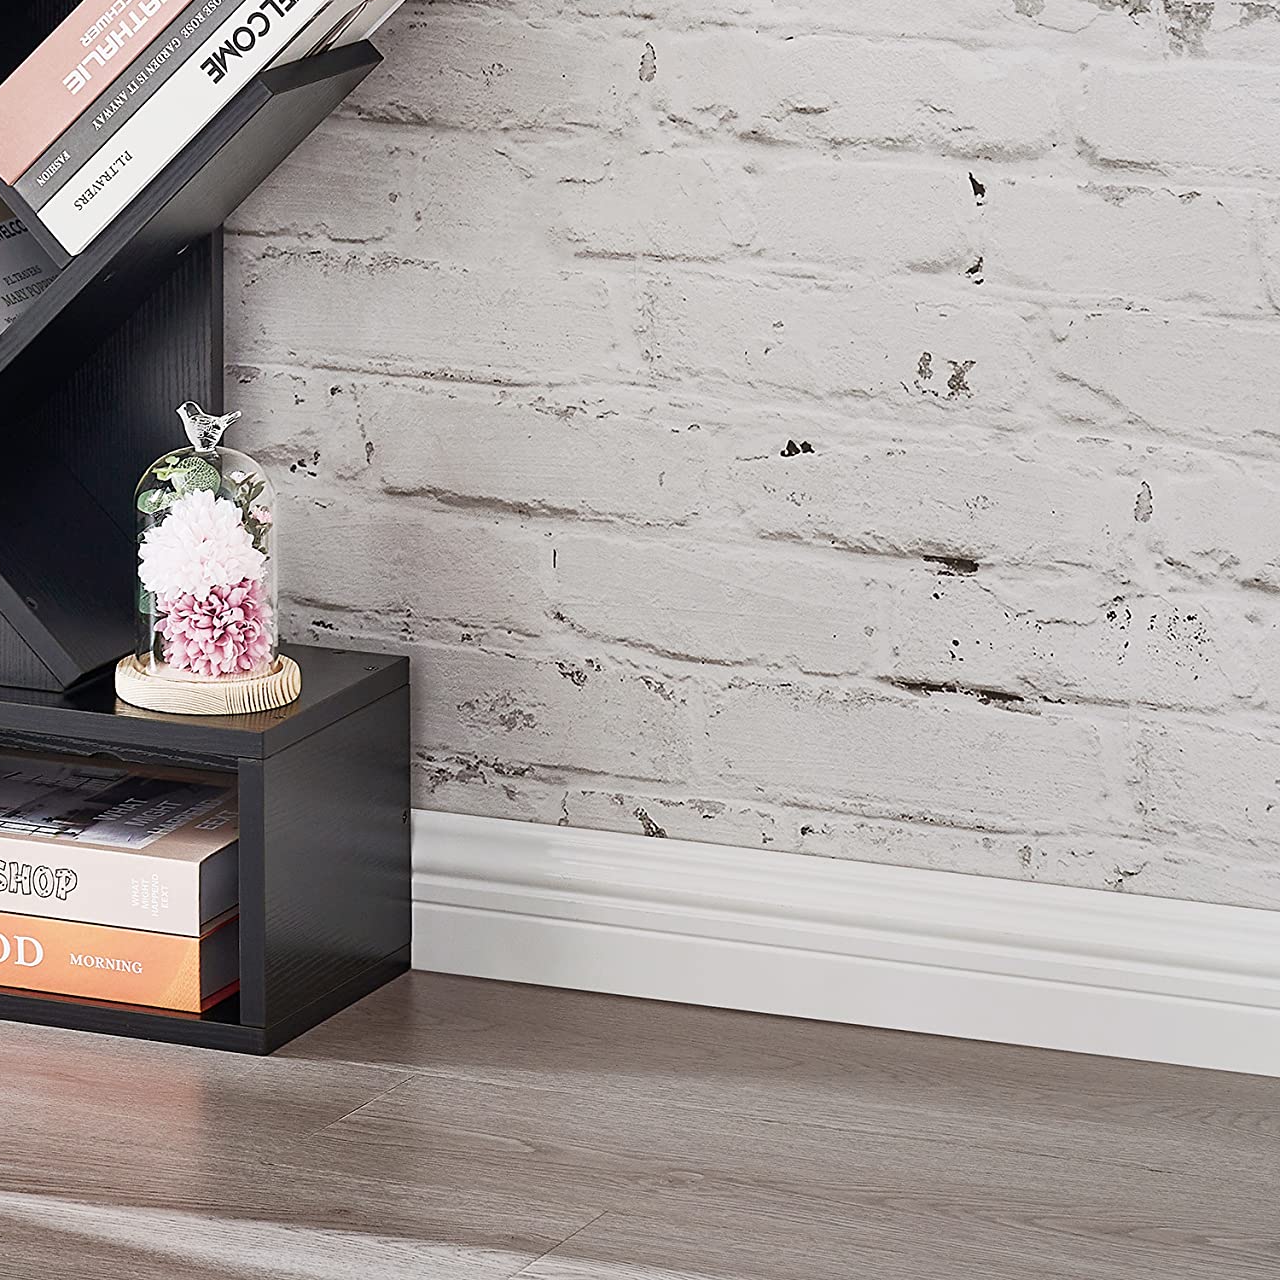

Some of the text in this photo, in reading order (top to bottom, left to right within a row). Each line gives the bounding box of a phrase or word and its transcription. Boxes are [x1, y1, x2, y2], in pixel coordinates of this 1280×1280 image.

[178, 10, 206, 40] ROSE
[143, 35, 182, 76] GARDEN
[124, 79, 141, 97] IT
[134, 69, 150, 86] IS
[89, 89, 130, 132] ANYWAY
[35, 148, 71, 188] FASHION
[74, 151, 132, 210] P.L.TRAVERS
[1, 288, 29, 307] MARY
[93, 798, 149, 821] WHAT
[124, 800, 182, 827] MIGHT
[131, 878, 140, 907] WHAT
[141, 879, 150, 910] MIGHT
[151, 873, 159, 917] HAPPEND
[69, 953, 144, 975] MORNING
